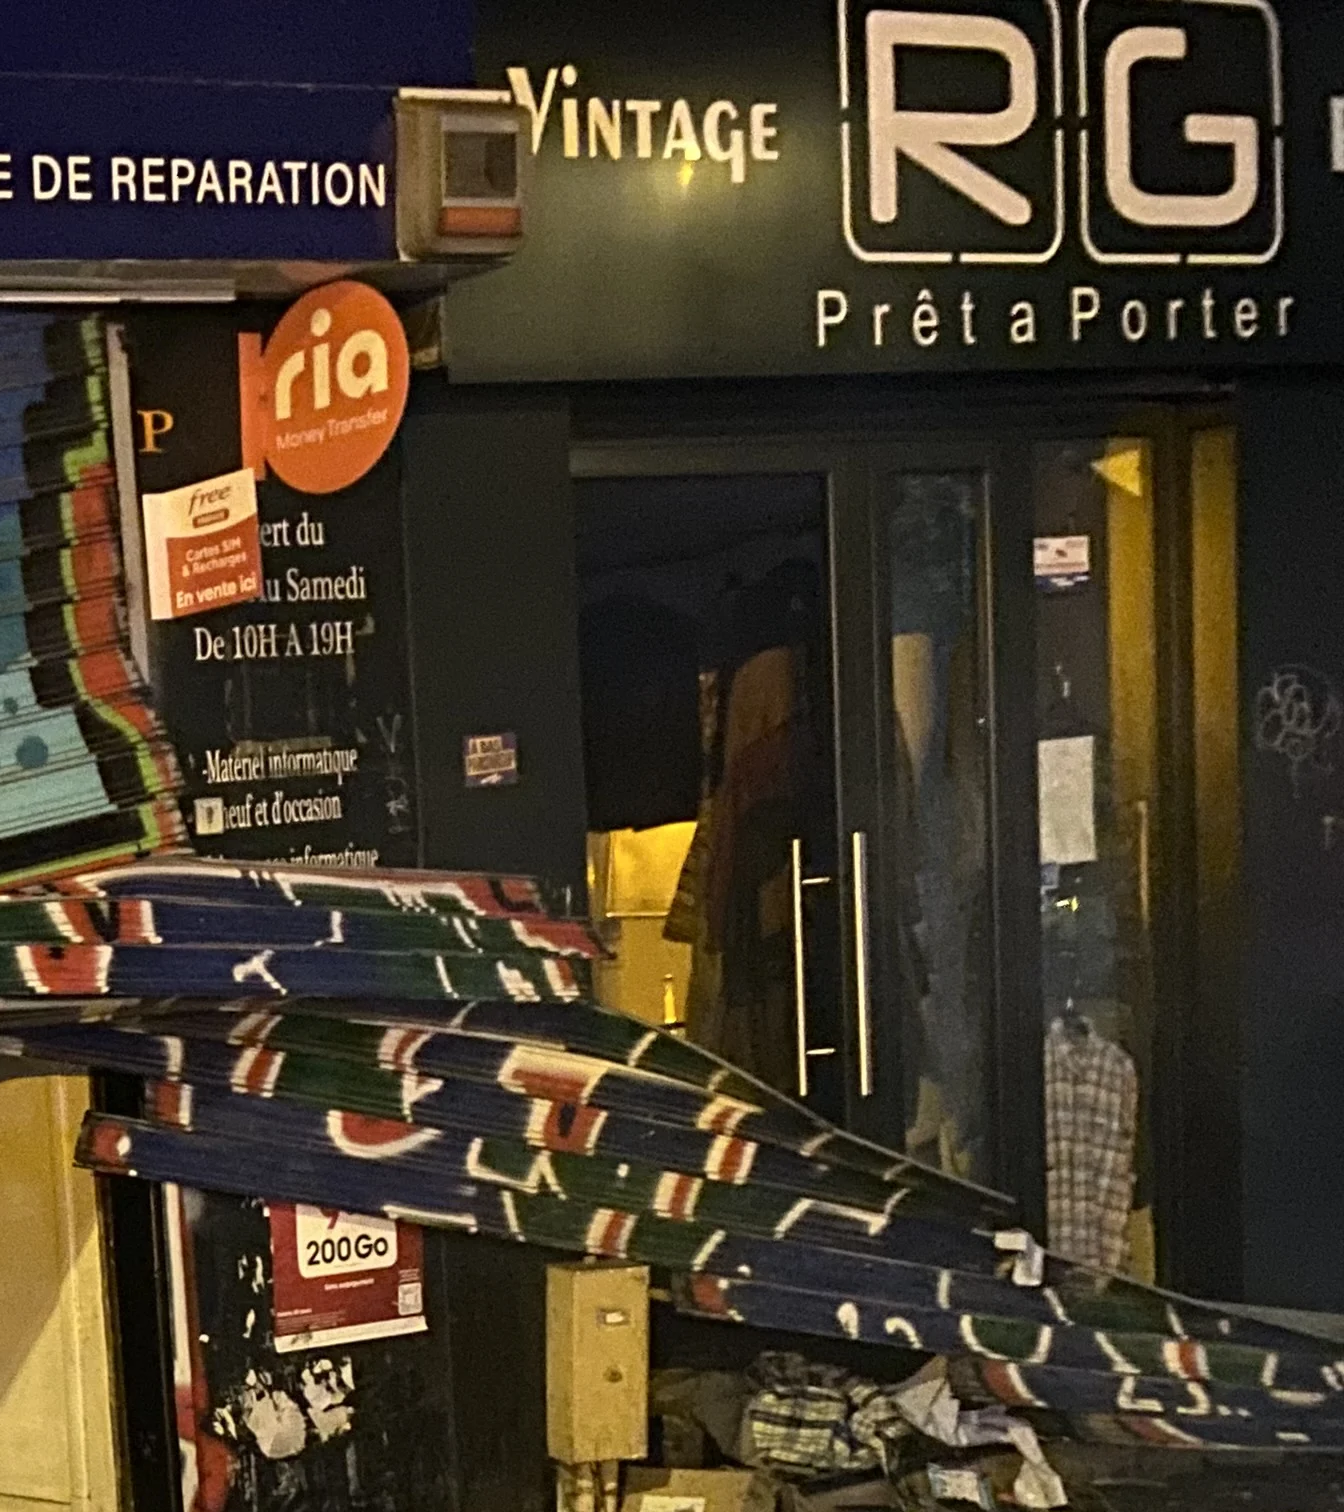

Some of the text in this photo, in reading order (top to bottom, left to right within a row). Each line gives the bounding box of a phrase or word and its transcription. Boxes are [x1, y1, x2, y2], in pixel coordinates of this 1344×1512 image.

[32, 154, 93, 201] DE
[111, 158, 386, 208] REPARATION
[816, 286, 1296, 348] Prêt a Porter
[274, 307, 389, 421] ria
[137, 409, 175, 454] P
[275, 406, 389, 452] Money Transfer
[187, 483, 233, 517] free
[256, 518, 291, 548] ert
[297, 511, 325, 547] du
[175, 570, 258, 610] En vente ici
[259, 564, 368, 603] u Samedi
[194, 619, 356, 663] De 10H A 19H
[268, 746, 360, 787] informatique
[254, 797, 269, 828] et
[271, 788, 344, 826] d'occasion
